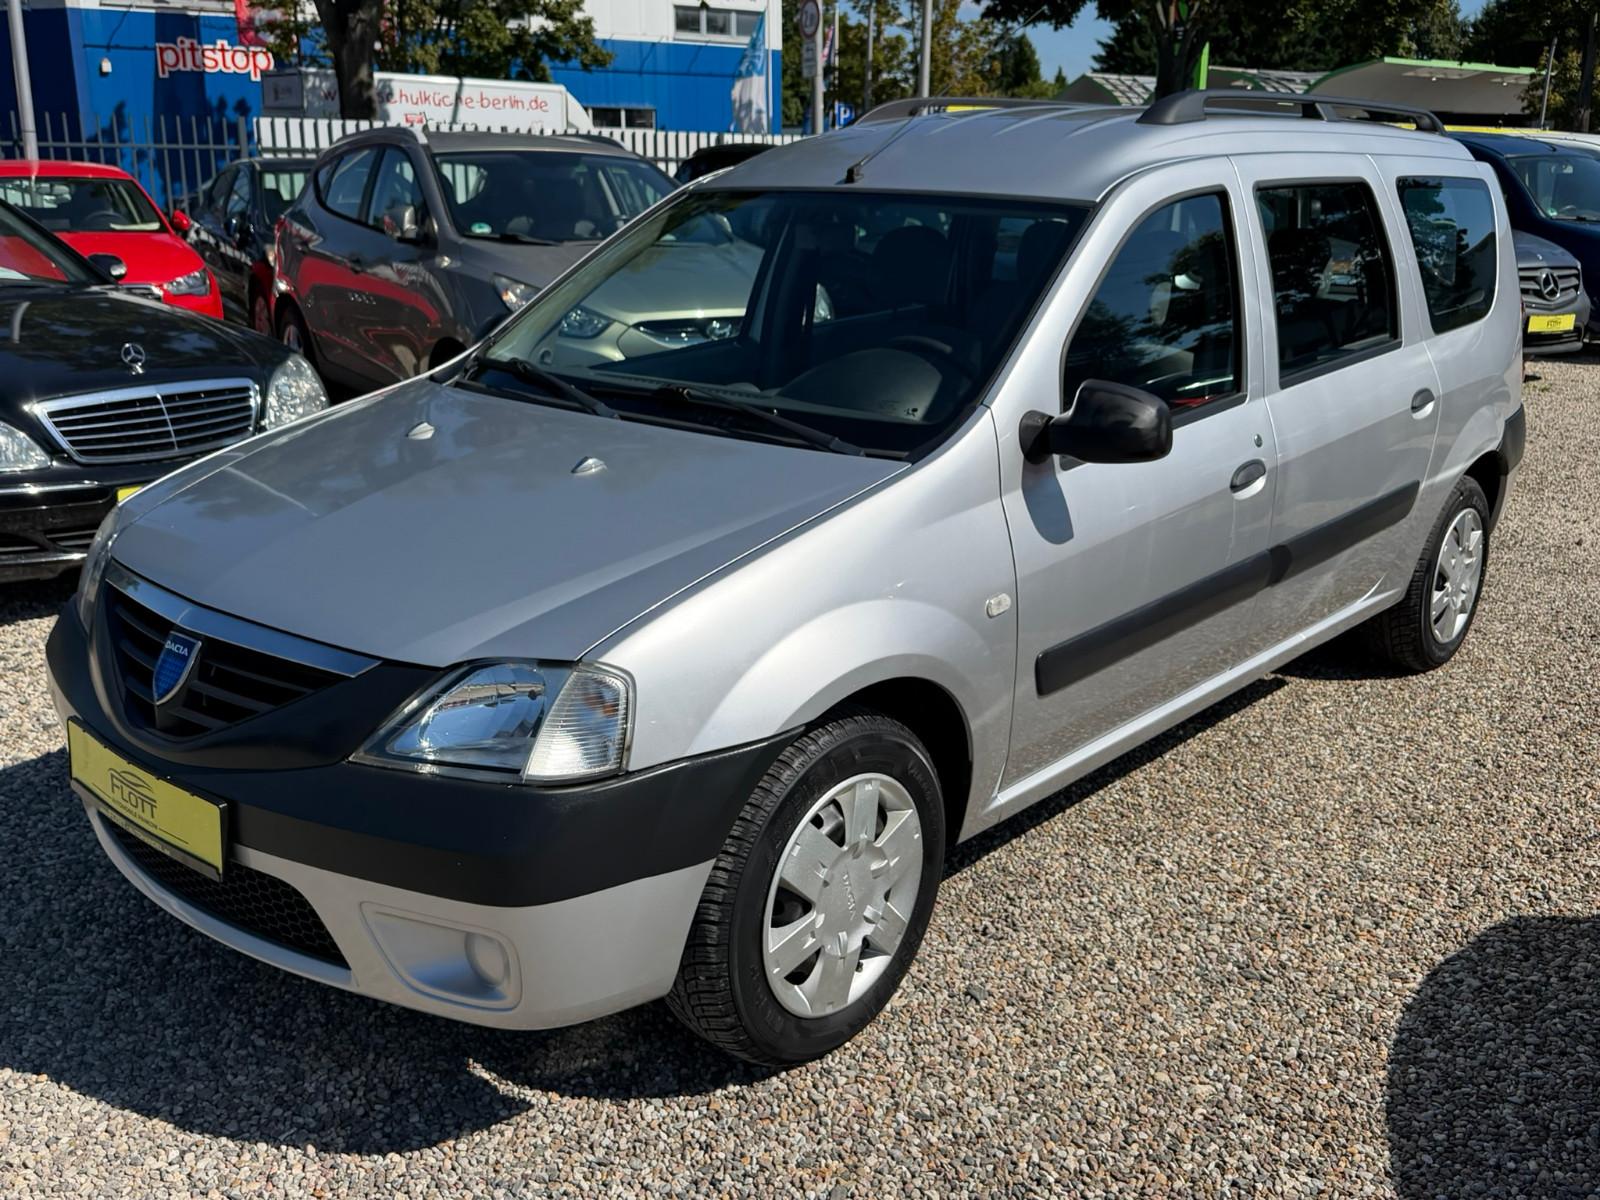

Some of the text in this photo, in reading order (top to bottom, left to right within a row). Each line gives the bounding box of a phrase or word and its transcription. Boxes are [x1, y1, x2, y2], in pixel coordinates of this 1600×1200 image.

[156, 37, 274, 81] pitstop
[840, 107, 850, 125] P
[164, 639, 188, 657] DACIA
[110, 773, 157, 819] FLOTT
